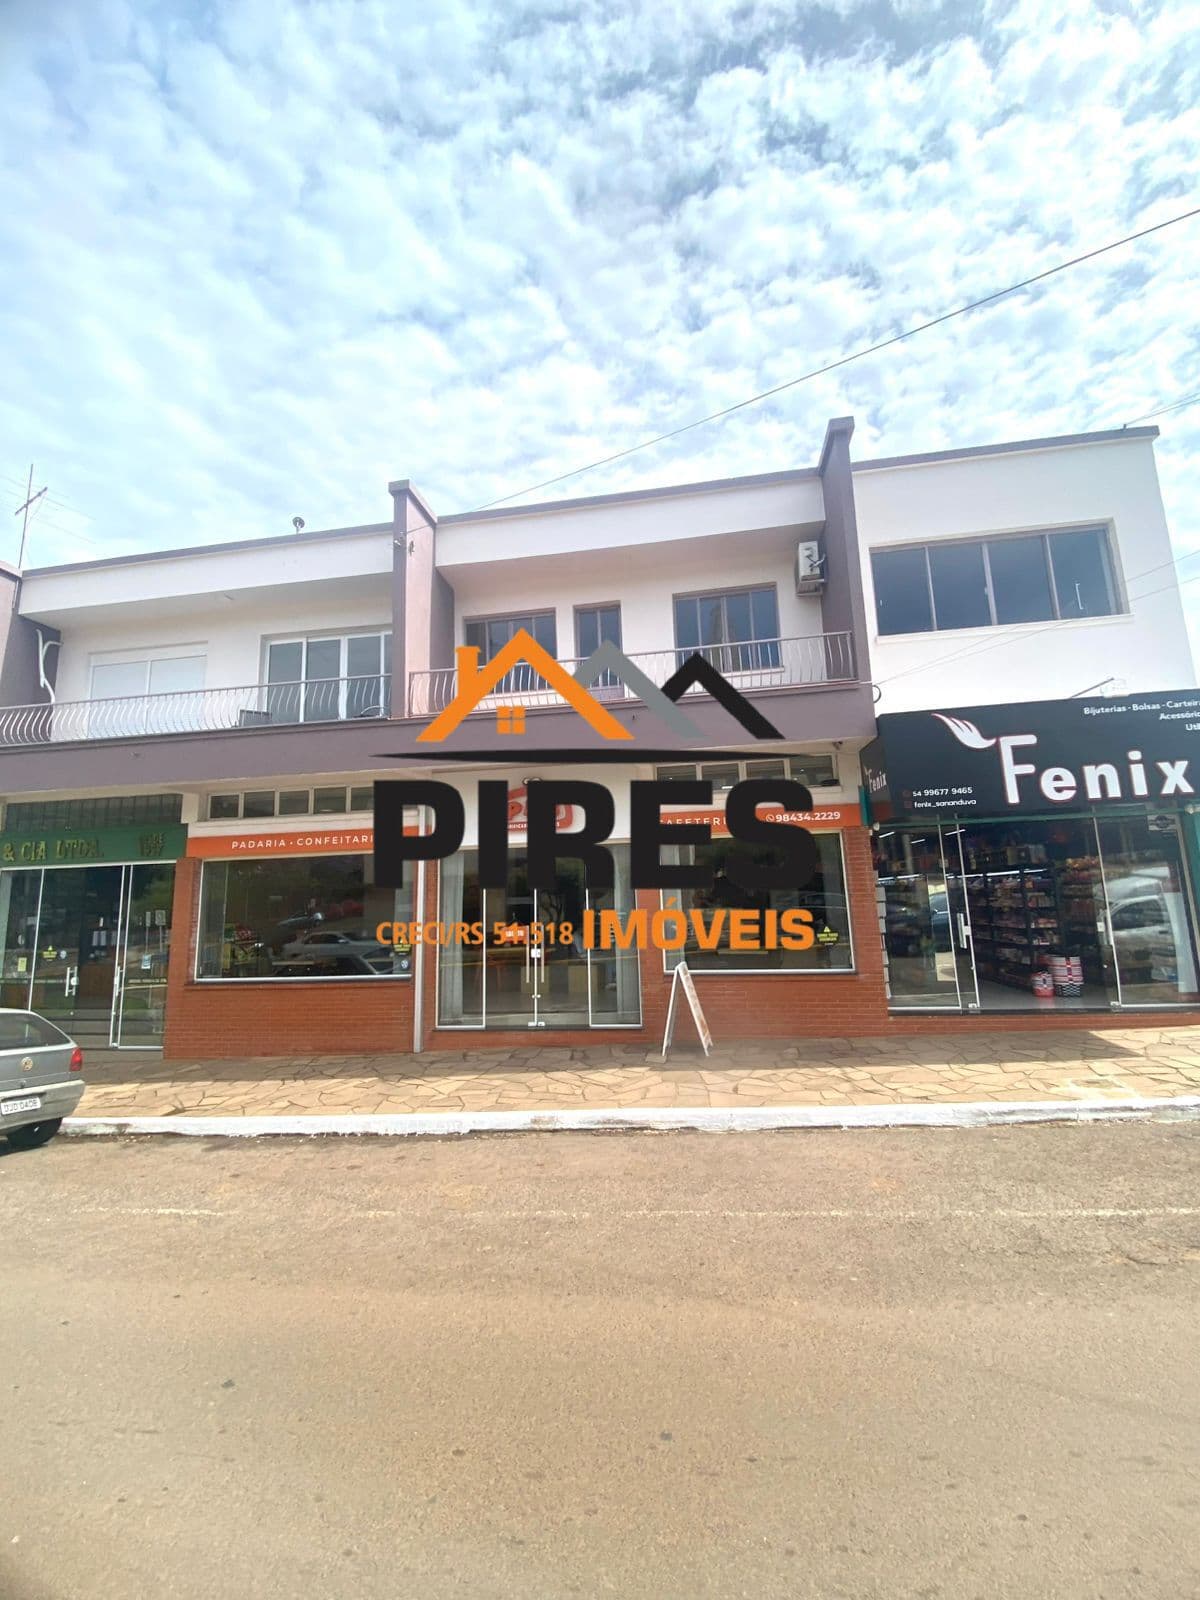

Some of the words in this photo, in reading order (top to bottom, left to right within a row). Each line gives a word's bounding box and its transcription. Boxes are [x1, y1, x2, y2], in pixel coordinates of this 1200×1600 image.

[1083, 706, 1127, 715] Bijuterias
[1132, 702, 1161, 711] Bolsas
[1166, 700, 1200, 709] Carteir
[1000, 734, 1194, 804] Fenix
[866, 768, 887, 793] Fenix
[923, 788, 949, 796] 99677
[951, 786, 973, 795] 9465
[660, 816, 726, 825] AFETERI
[775, 811, 841, 823] 98434.2229
[231, 839, 286, 849] PADARIA
[296, 835, 374, 846] CONFEITARI
[21, 841, 46, 861] CIA
